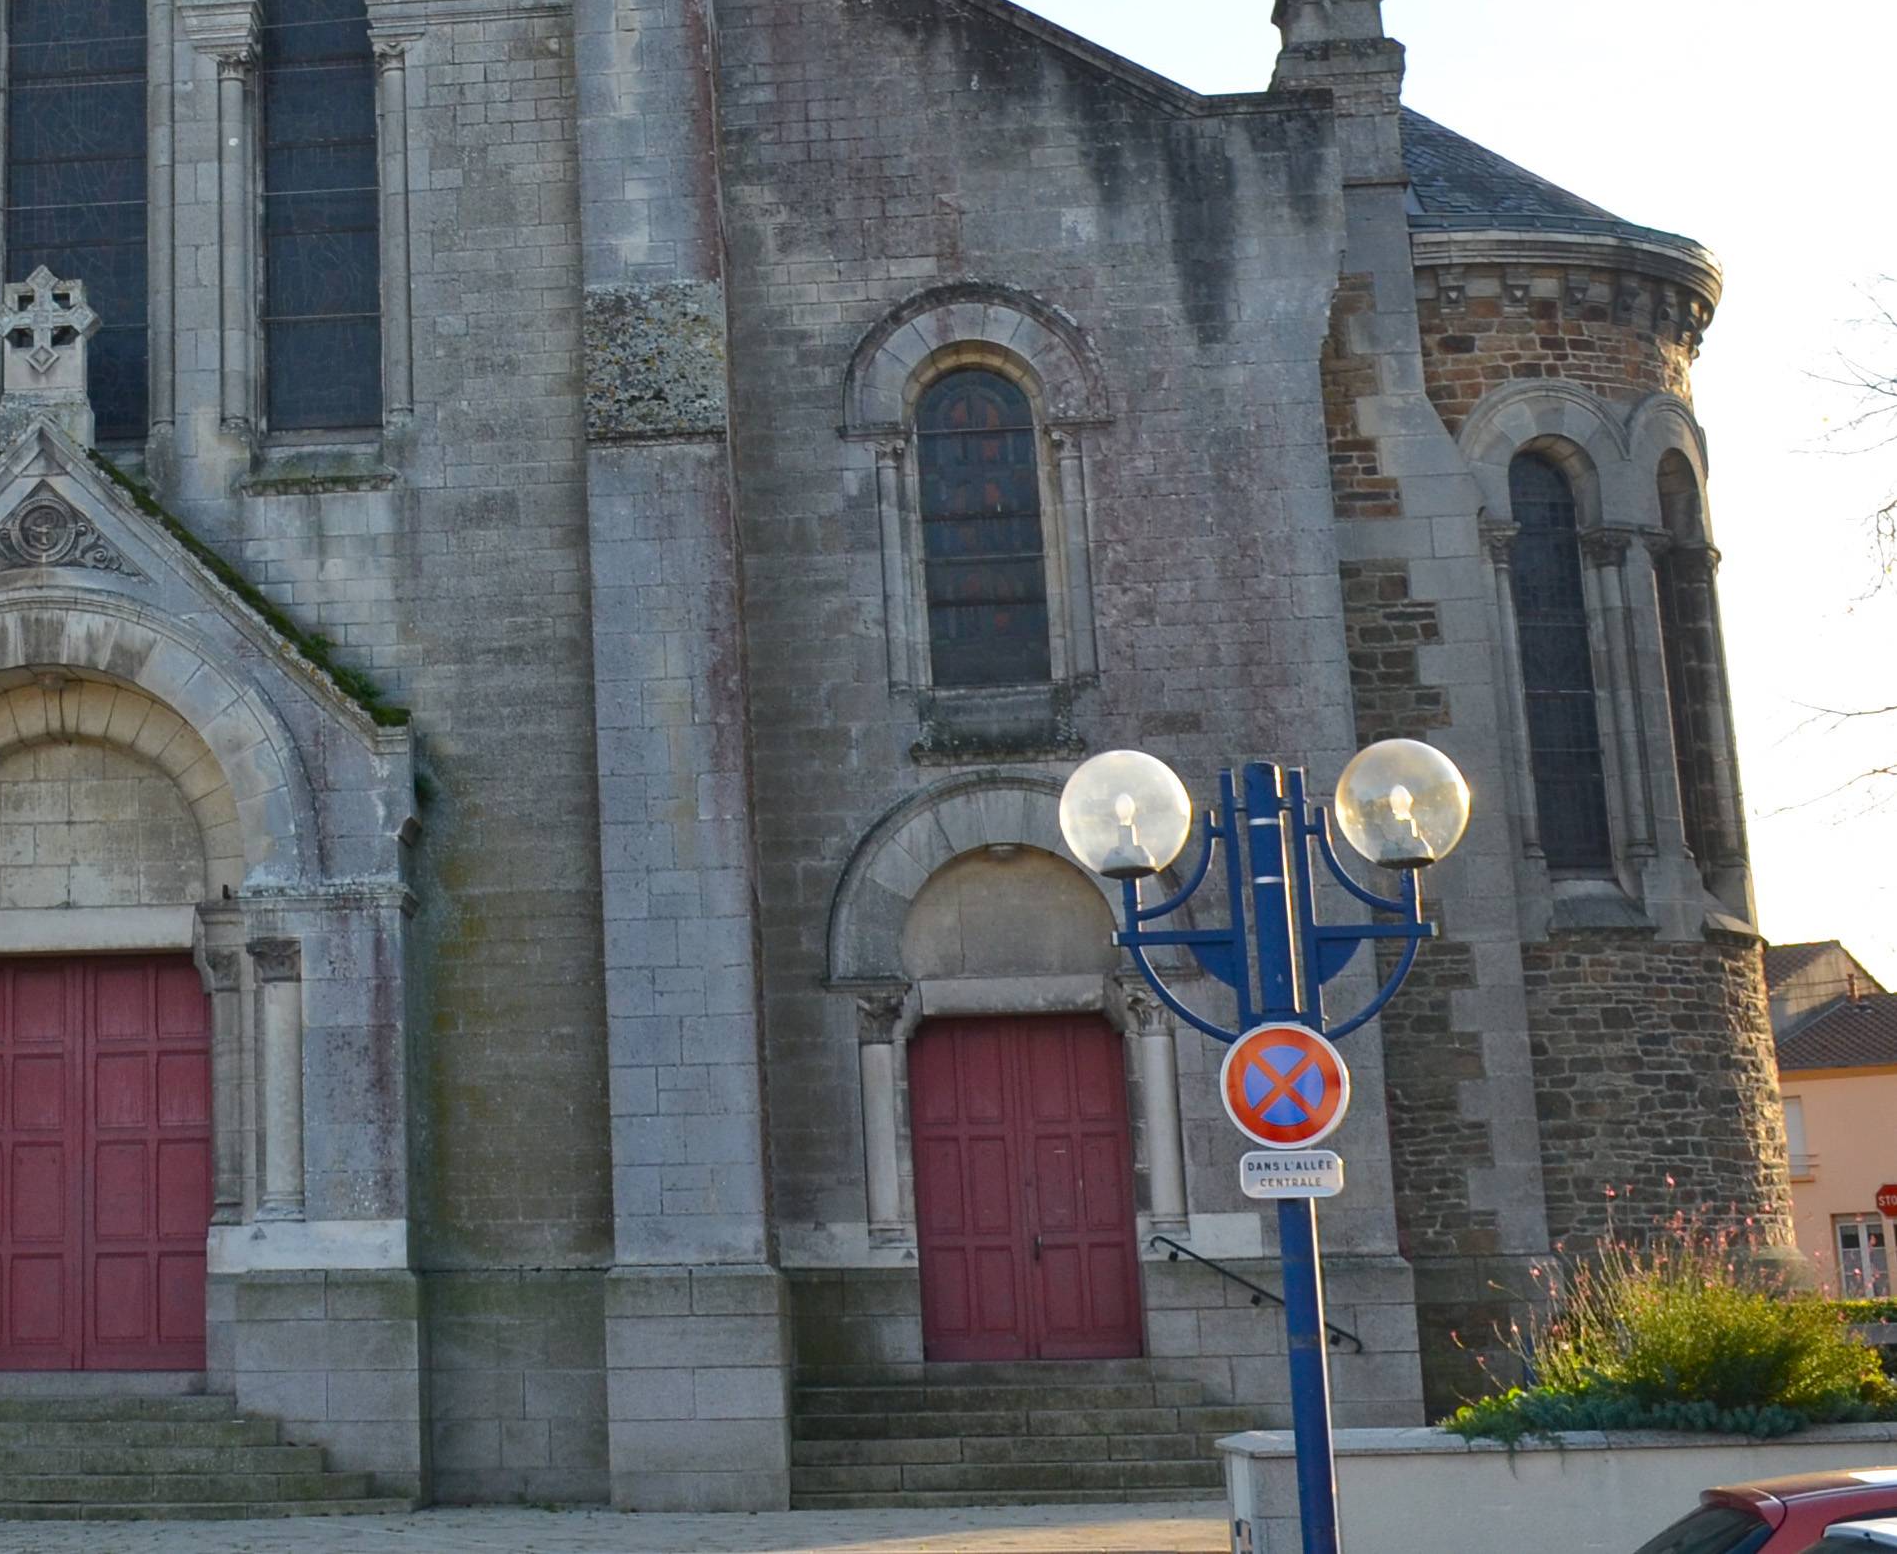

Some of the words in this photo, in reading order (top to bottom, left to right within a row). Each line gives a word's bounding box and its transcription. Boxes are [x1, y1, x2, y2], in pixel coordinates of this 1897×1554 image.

[1247, 1161, 1280, 1172] DANS
[1284, 1159, 1333, 1171] L'ALLÉE
[1260, 1177, 1322, 1187] CENTRALE
[1878, 1195, 1897, 1206] STO
